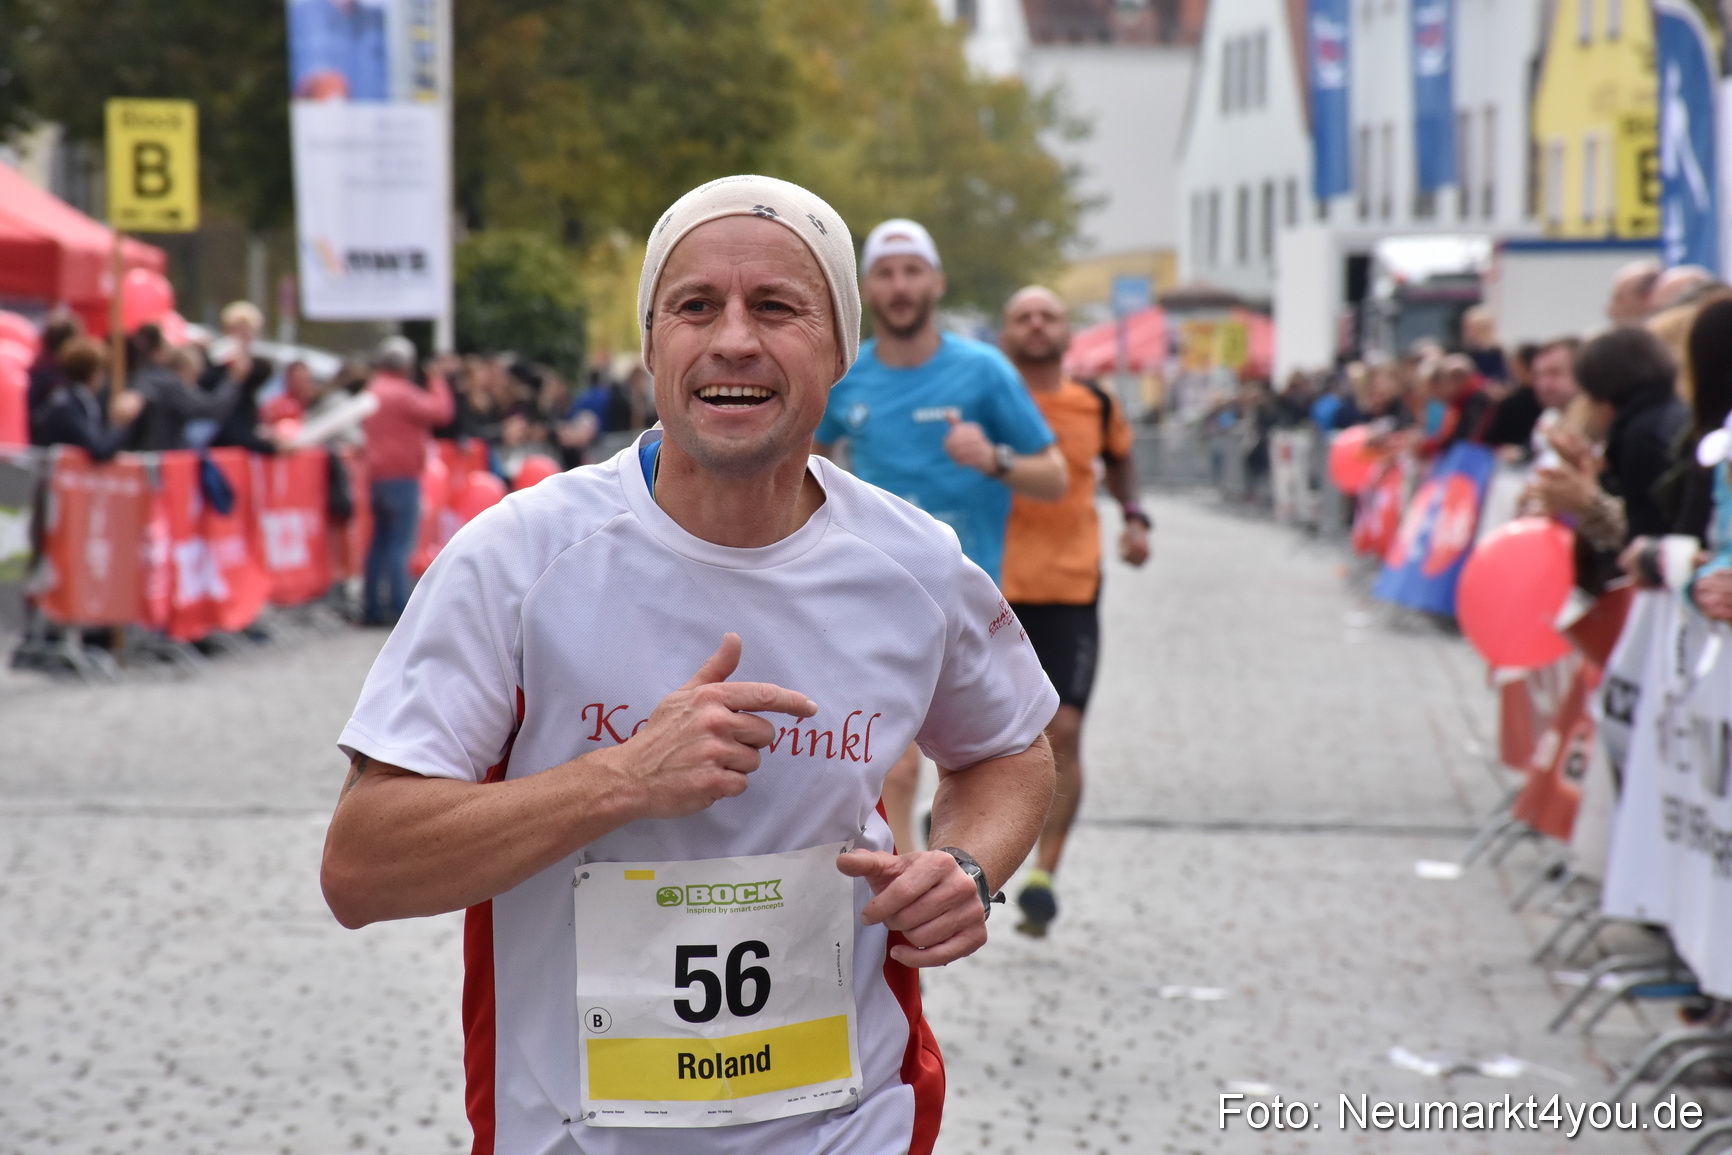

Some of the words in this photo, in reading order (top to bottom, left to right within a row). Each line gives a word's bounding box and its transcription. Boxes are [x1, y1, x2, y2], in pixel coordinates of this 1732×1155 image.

[131, 140, 174, 199] B
[686, 879, 783, 906] BOCK
[686, 906, 717, 915] inspired
[718, 906, 728, 915] by
[729, 905, 751, 913] smart
[752, 901, 784, 912] concepts
[673, 939, 772, 1024] 56
[592, 1014, 604, 1028] B
[677, 1044, 771, 1080] Roland
